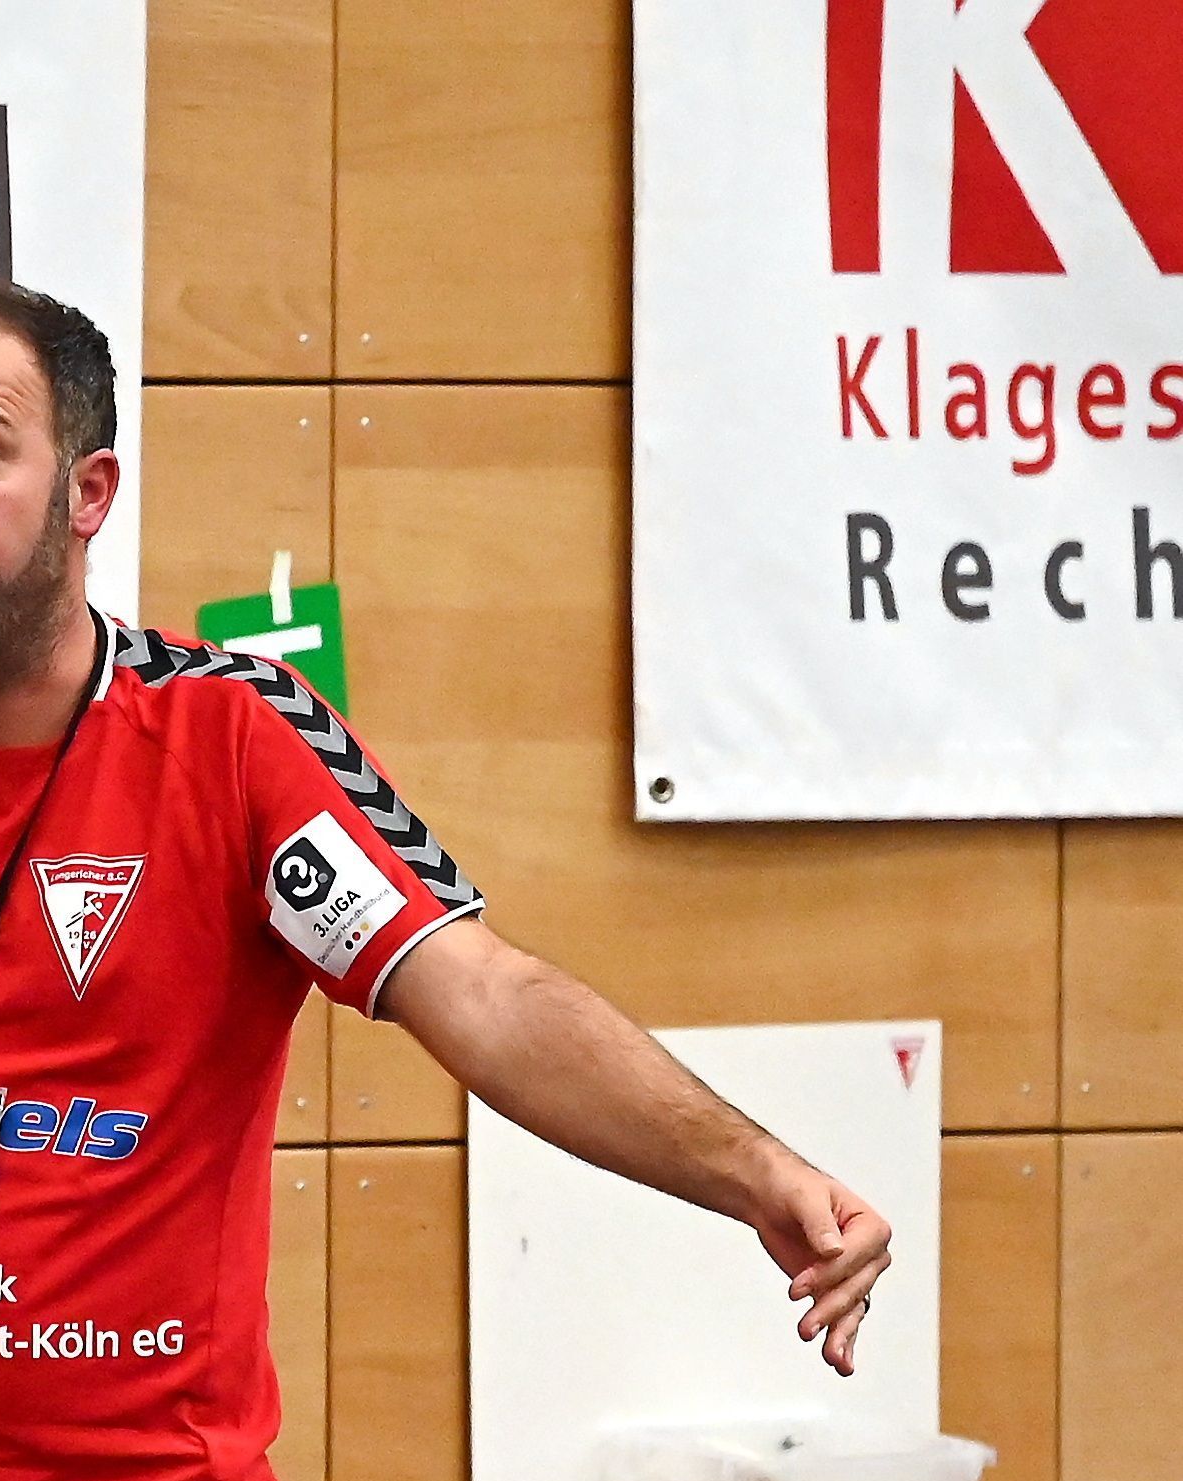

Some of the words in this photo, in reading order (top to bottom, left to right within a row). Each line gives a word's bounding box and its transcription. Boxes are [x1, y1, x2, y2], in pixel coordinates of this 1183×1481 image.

[835, 327, 1183, 476] Klages
[846, 505, 1183, 622] Rech
[322, 890, 362, 926] LIGA
[132, 1319, 184, 1356] eG
